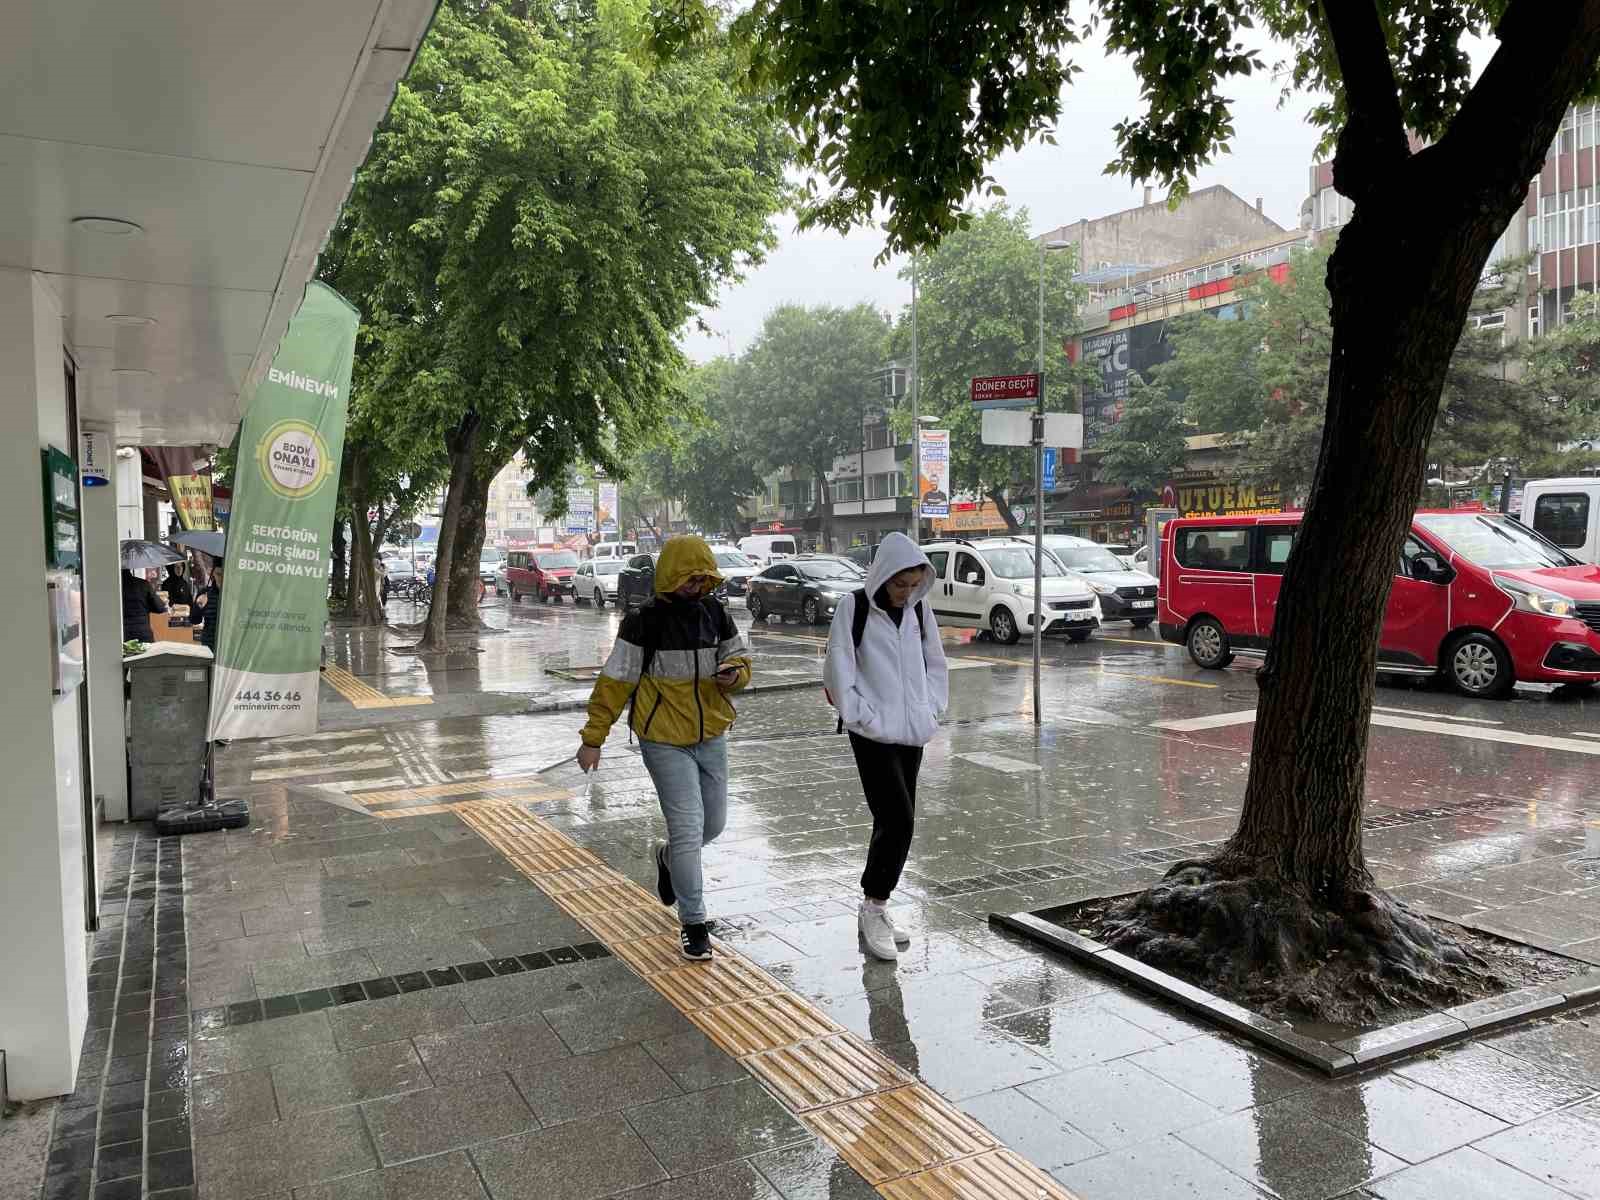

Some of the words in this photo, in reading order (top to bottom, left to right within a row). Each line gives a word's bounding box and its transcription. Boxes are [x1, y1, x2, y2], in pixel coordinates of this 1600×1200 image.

[268, 367, 339, 399] EMİNEVİM
[975, 381, 1006, 392] DÖNER
[1008, 378, 1034, 390] GEÇİT
[273, 451, 315, 468] ONAYLI
[252, 524, 318, 544] SEKTÖRÜN
[245, 539, 282, 557] LİDERİ
[283, 544, 321, 561] ŞİMDİ
[238, 558, 273, 573] BDDK
[275, 563, 324, 579] ONAYLI
[234, 691, 261, 702] 444
[263, 691, 281, 702] 36
[284, 691, 302, 702] 46
[234, 702, 301, 711] eminevim.com
